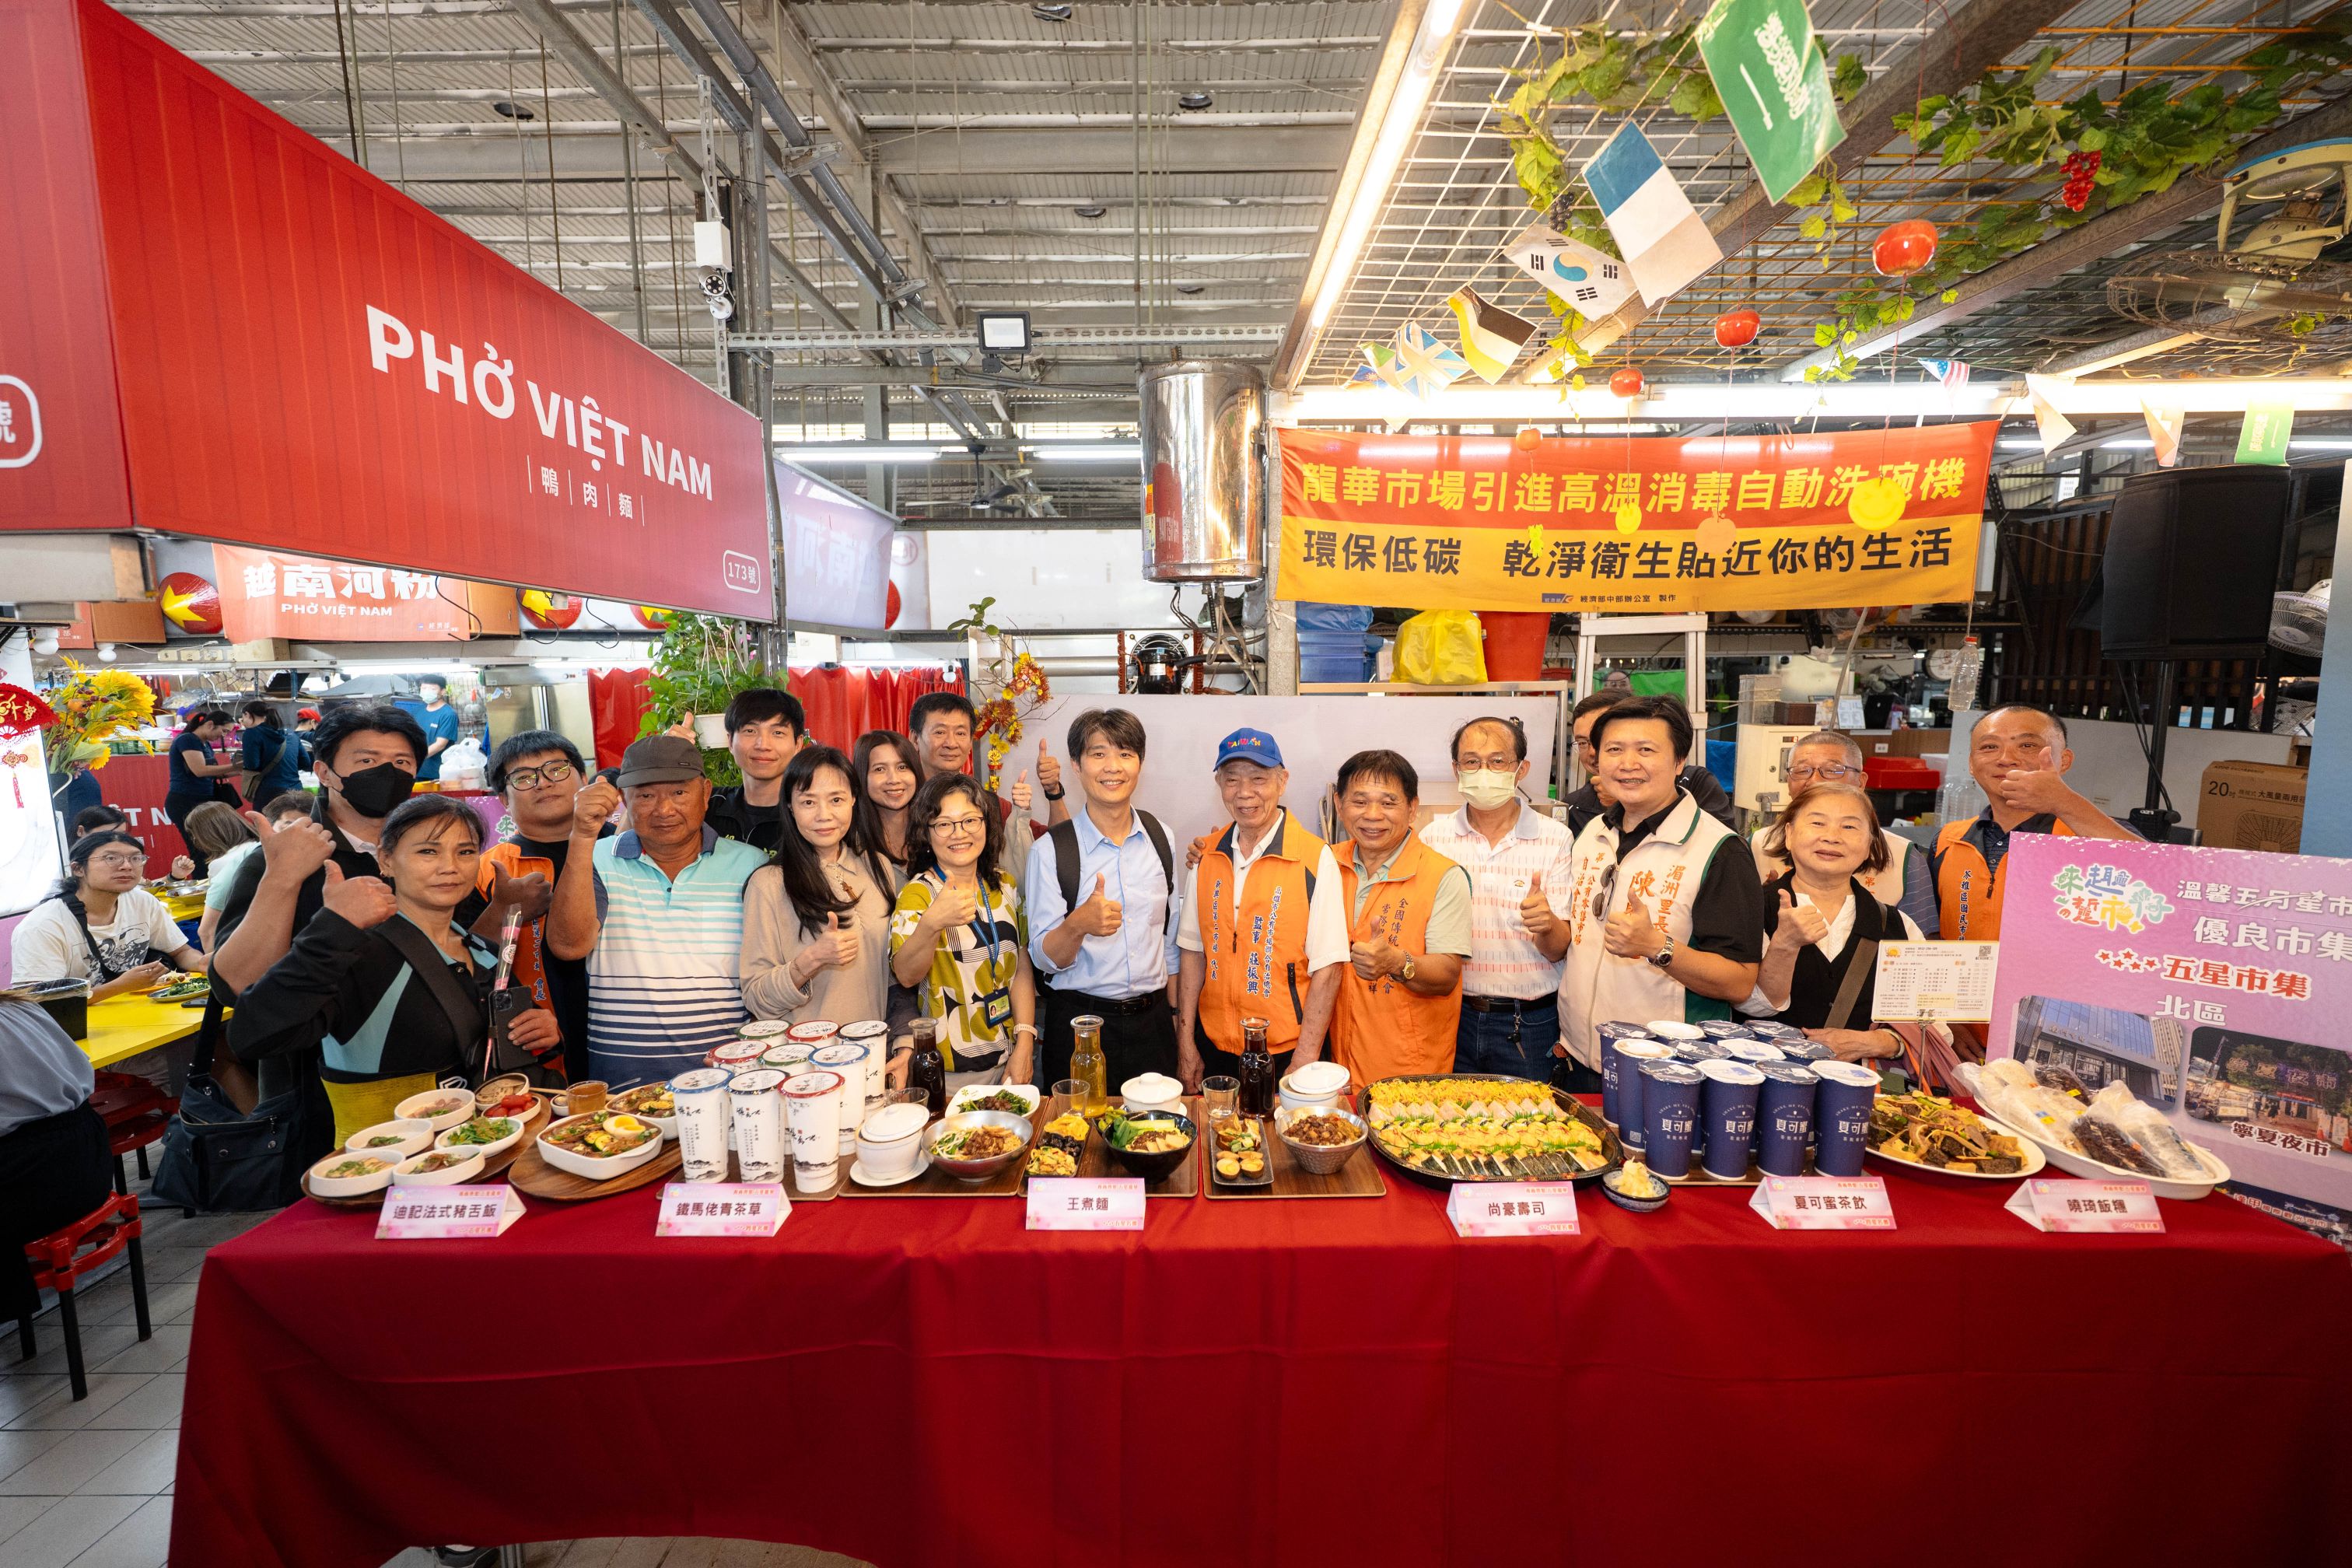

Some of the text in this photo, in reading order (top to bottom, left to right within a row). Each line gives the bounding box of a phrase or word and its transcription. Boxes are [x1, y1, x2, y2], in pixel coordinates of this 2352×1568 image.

[366, 304, 712, 501] PHỞ VIỆT NAM
[1303, 527, 1952, 579] 環保低碳 乾淨衛生貼近你的生活
[243, 562, 441, 600] 越南河粉
[728, 562, 757, 584] 173號
[281, 602, 393, 618] PHỞ VIỆT NAM
[1252, 915, 1263, 943] 監事
[2193, 915, 2352, 961] 優良市集
[2164, 957, 2308, 999] 五星市集
[2155, 995, 2228, 1026] 北區
[2231, 1122, 2331, 1157] 寧夏夜市
[393, 1203, 498, 1220] 迪記法式豬舌飯
[676, 1202, 762, 1216] 鐵馬佬青茶草
[1067, 1197, 1109, 1211] 王煮麵
[1488, 1201, 1545, 1216] 尚豪壽司
[1794, 1195, 1867, 1210] 夏可蜜茶飲
